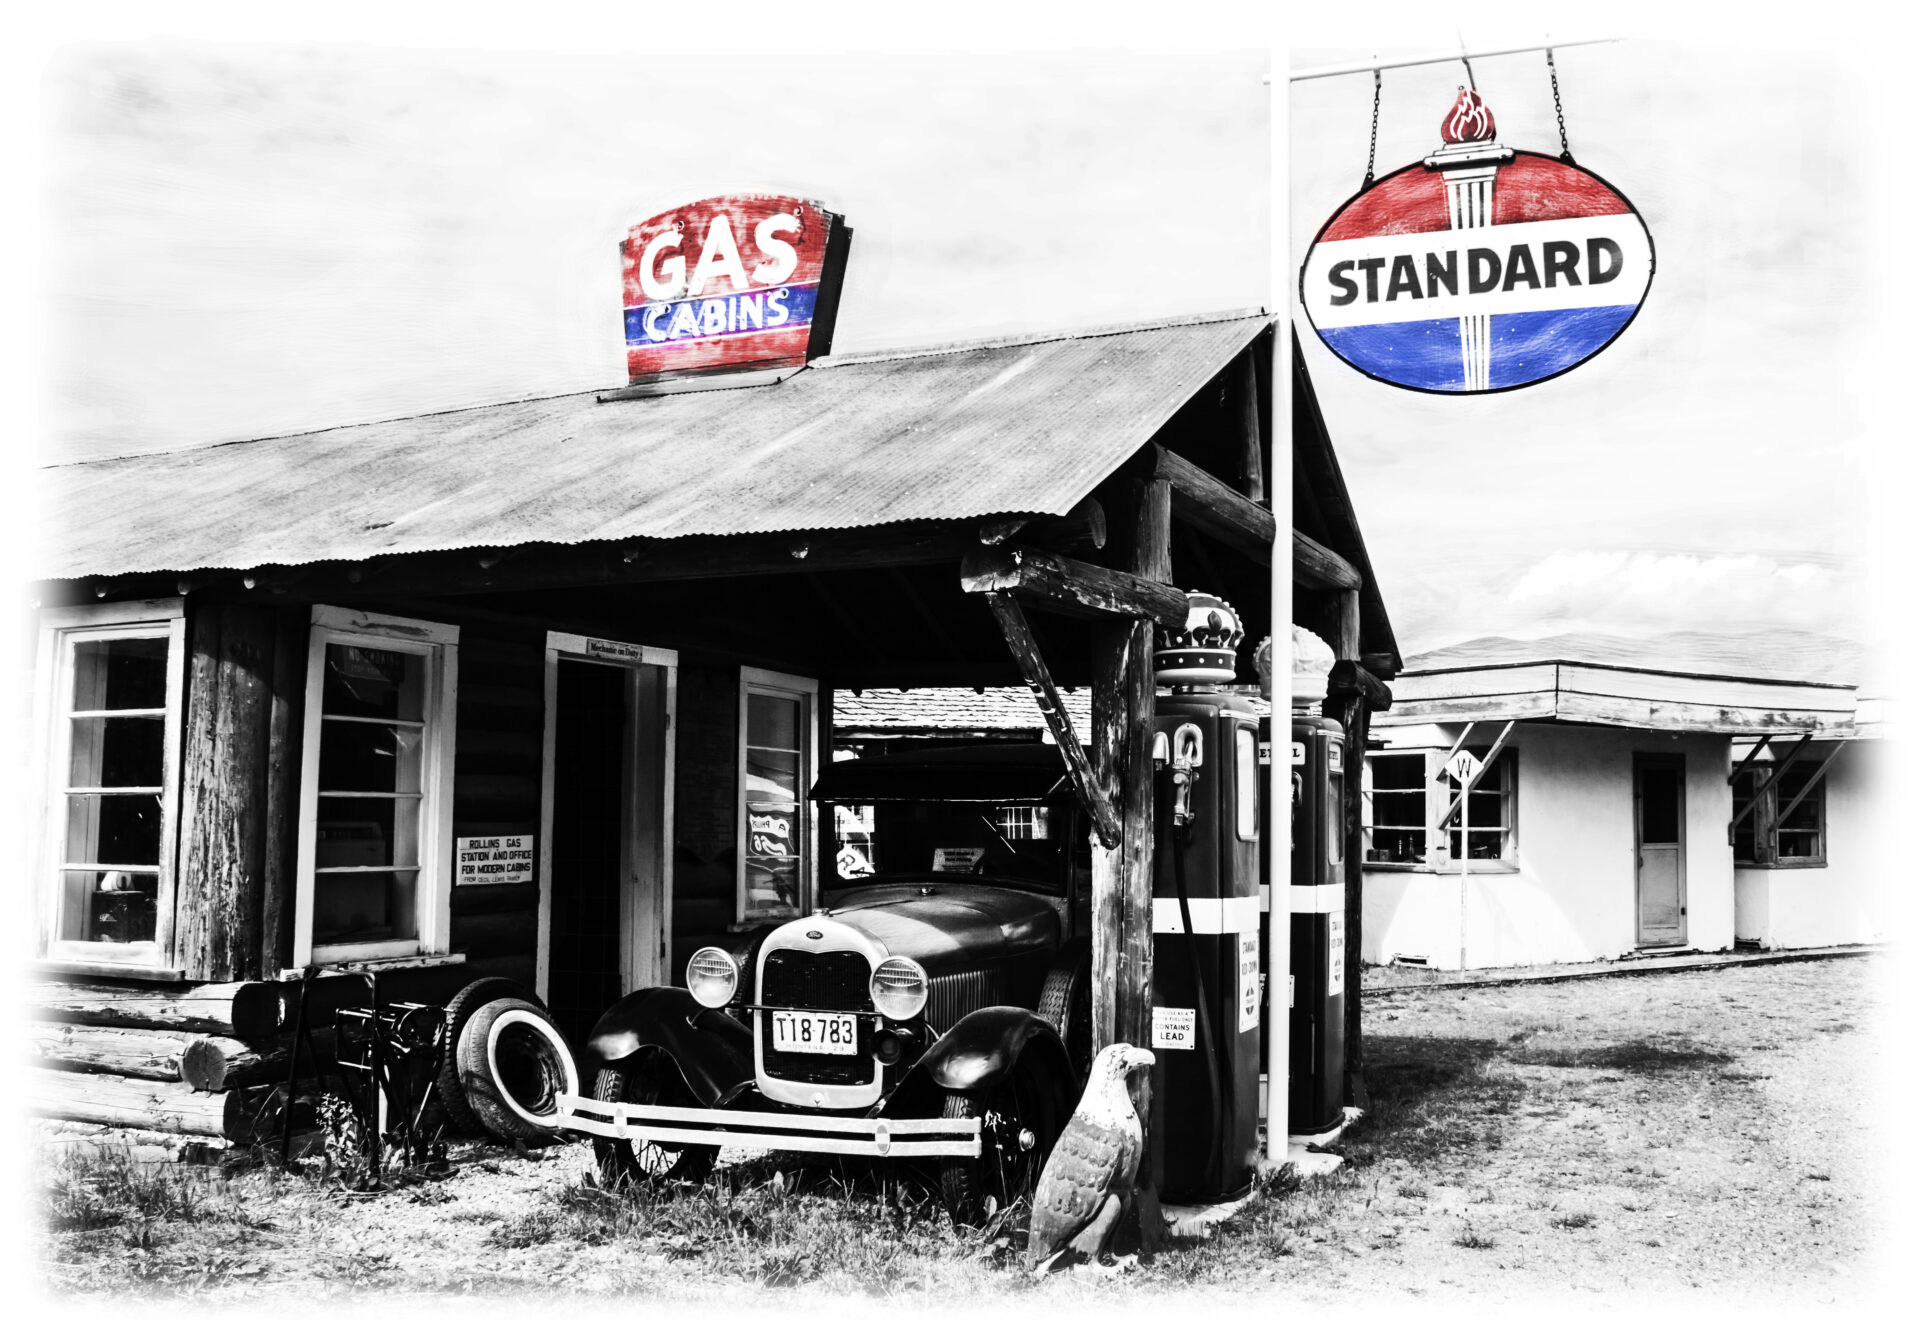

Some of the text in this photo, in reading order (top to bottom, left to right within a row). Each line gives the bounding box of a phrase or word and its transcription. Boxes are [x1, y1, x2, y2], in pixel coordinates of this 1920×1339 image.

[639, 213, 802, 301] GAS
[1329, 237, 1624, 307] STANDARD
[642, 290, 790, 343] CABINS
[590, 642, 617, 654] Mechanic
[625, 647, 639, 659] Duty
[1457, 757, 1472, 778] W
[469, 838, 521, 849] ROLLINS GAS
[461, 850, 532, 862] STATION AND OFFICE
[461, 862, 531, 875] FOR MODERN CABINS
[1154, 1023, 1190, 1031] CONTAINS
[1160, 1032, 1185, 1041] LEAD
